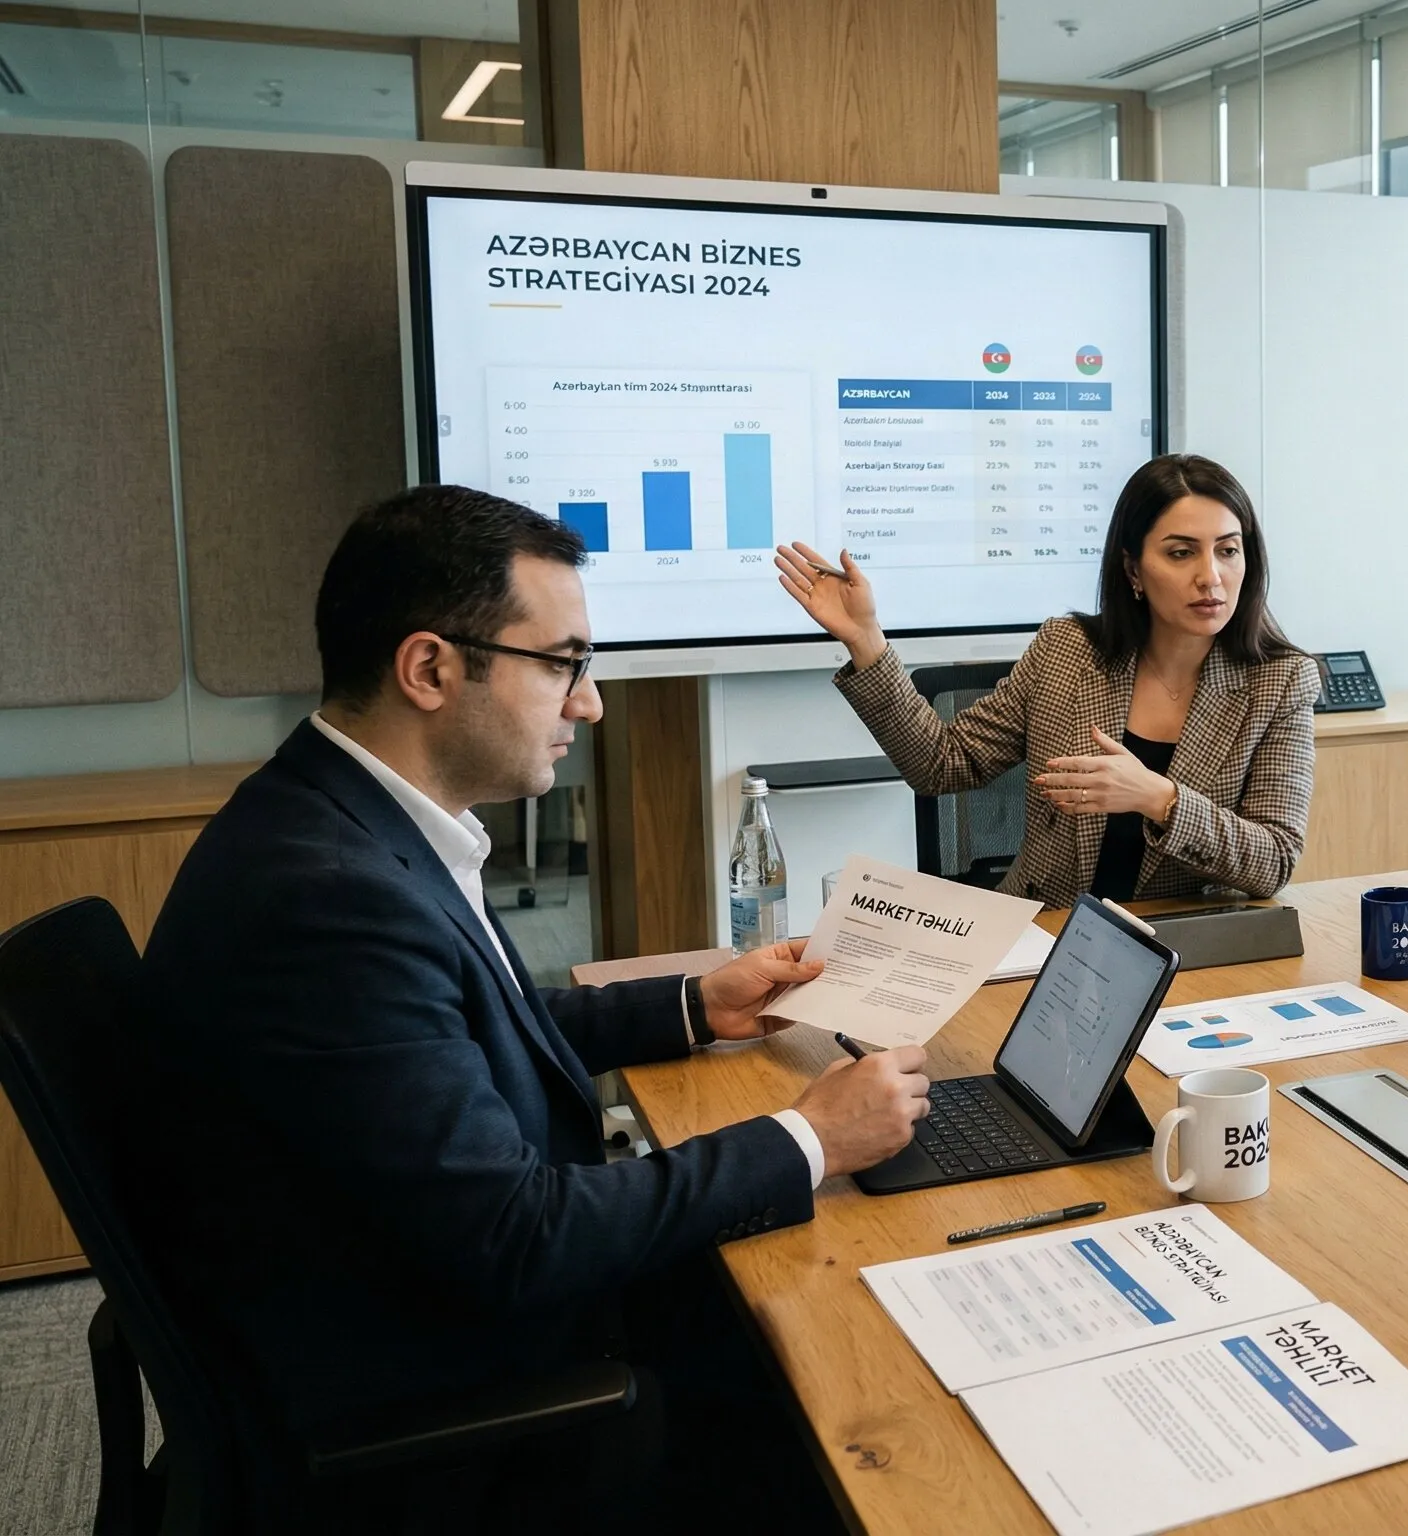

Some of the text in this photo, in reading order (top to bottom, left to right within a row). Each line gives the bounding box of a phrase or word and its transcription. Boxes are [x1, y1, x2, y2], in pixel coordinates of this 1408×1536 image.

[486, 234, 802, 267] AZƏRBAYCAN BİZNES
[488, 266, 770, 297] STRATEGİYASI 2024
[650, 382, 677, 392] 2024
[851, 893, 915, 922] MARKET
[915, 911, 974, 938] TƏHLİLİ
[1265, 1327, 1343, 1387] TƏHLİLİ
[1291, 1320, 1377, 1385] MARKET
